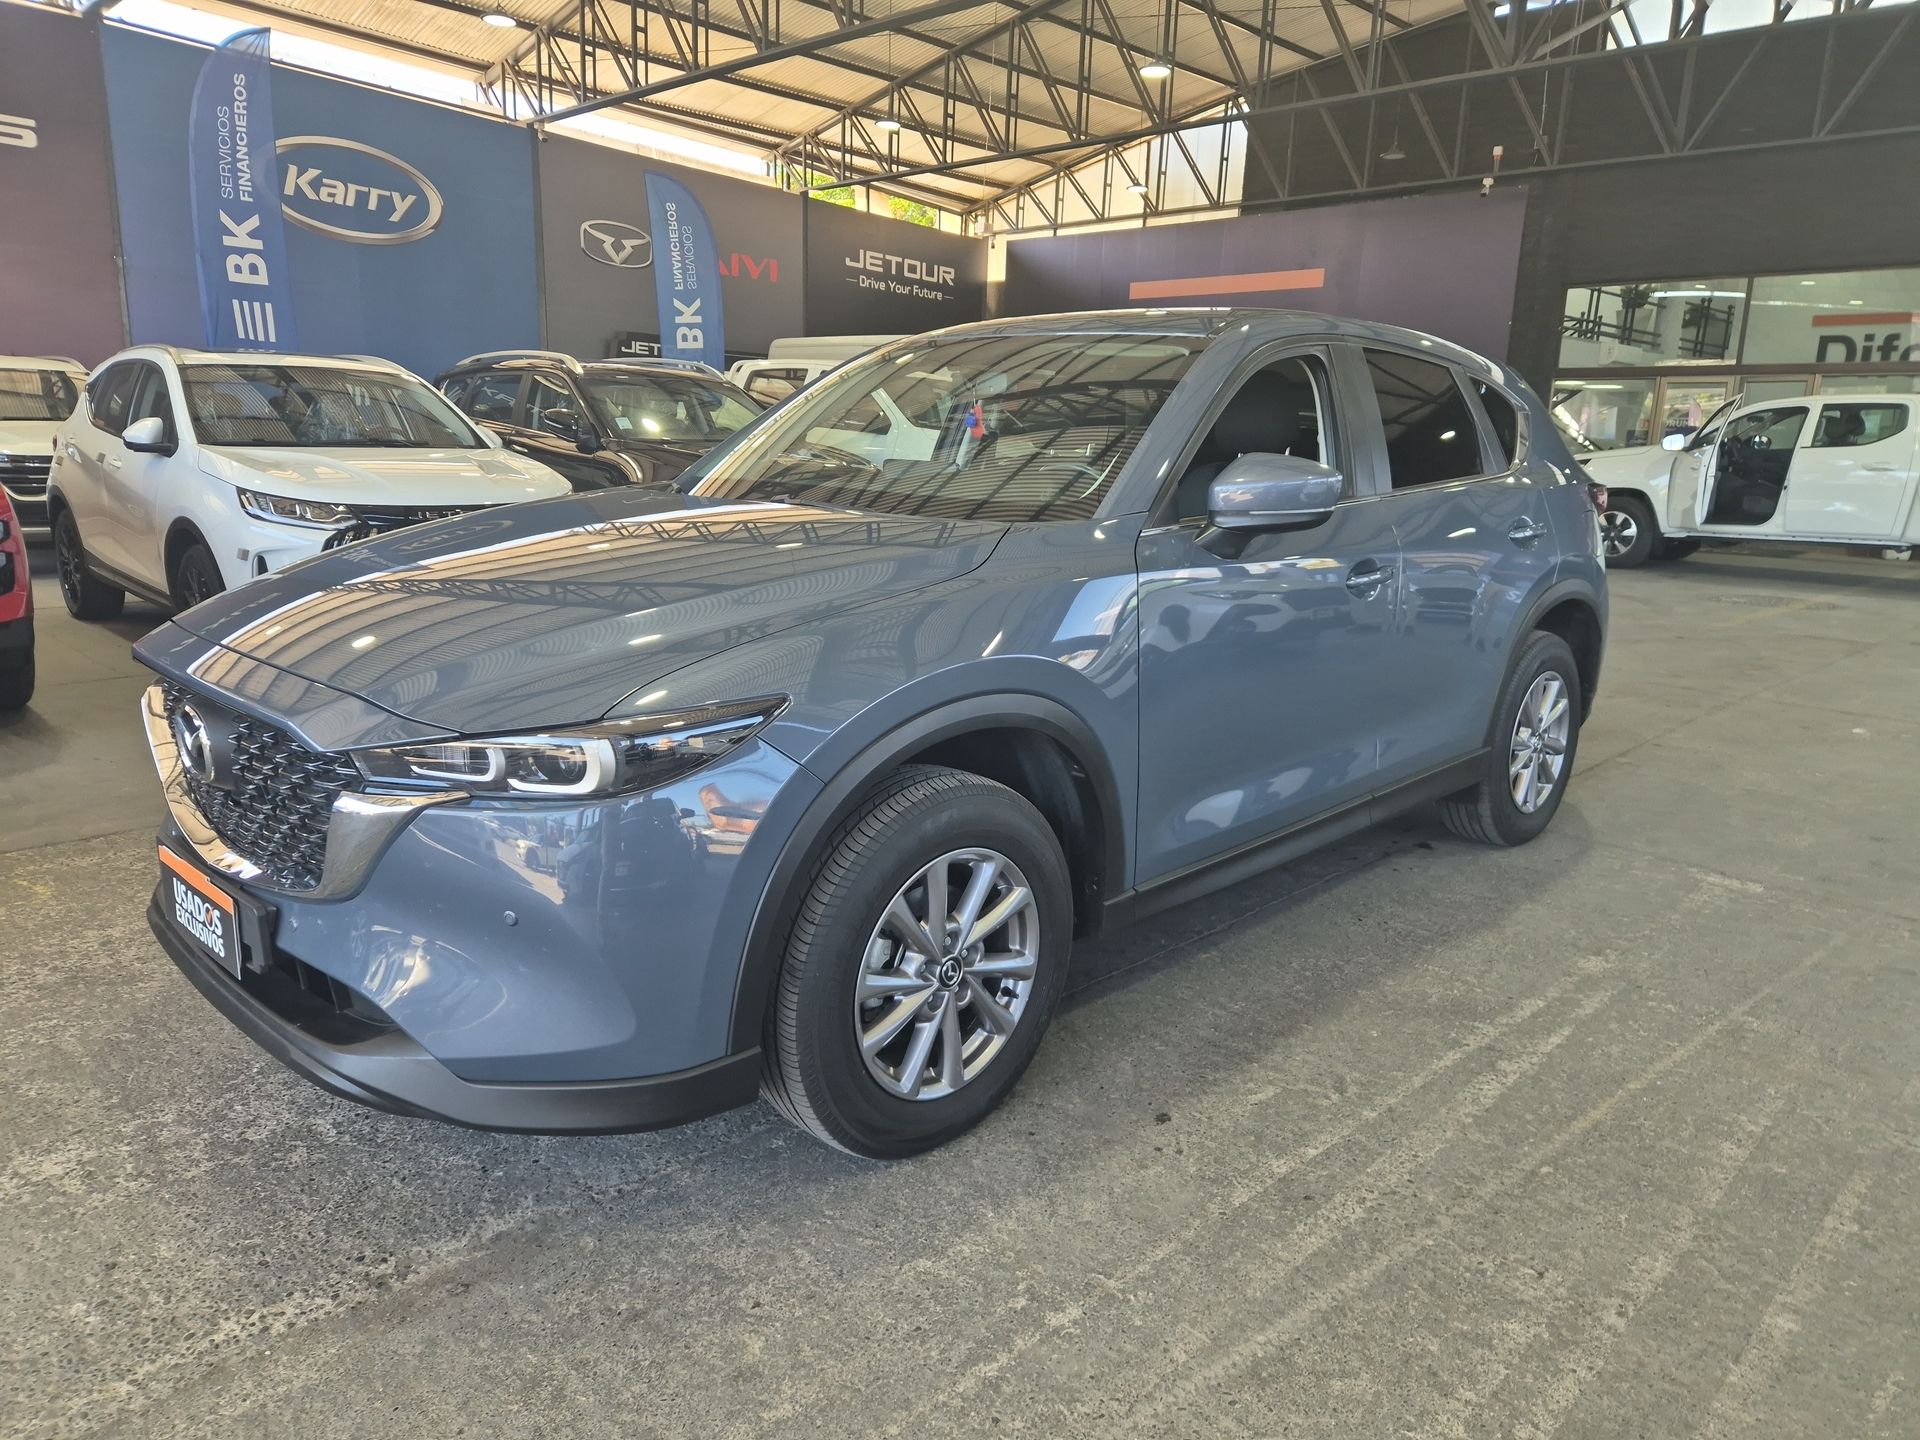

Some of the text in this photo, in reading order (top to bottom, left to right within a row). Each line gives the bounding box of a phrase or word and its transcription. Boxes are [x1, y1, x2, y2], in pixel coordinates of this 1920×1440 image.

[217, 106, 234, 200] SERVICIOS
[233, 73, 254, 202] FINANCIEROS
[283, 163, 417, 222] Karry
[219, 209, 269, 286] BK
[845, 249, 955, 286] JETOUR
[859, 275, 943, 300] Drive Your Future
[172, 877, 223, 936] USADOS
[176, 903, 225, 958] EXCLUSIVOS
